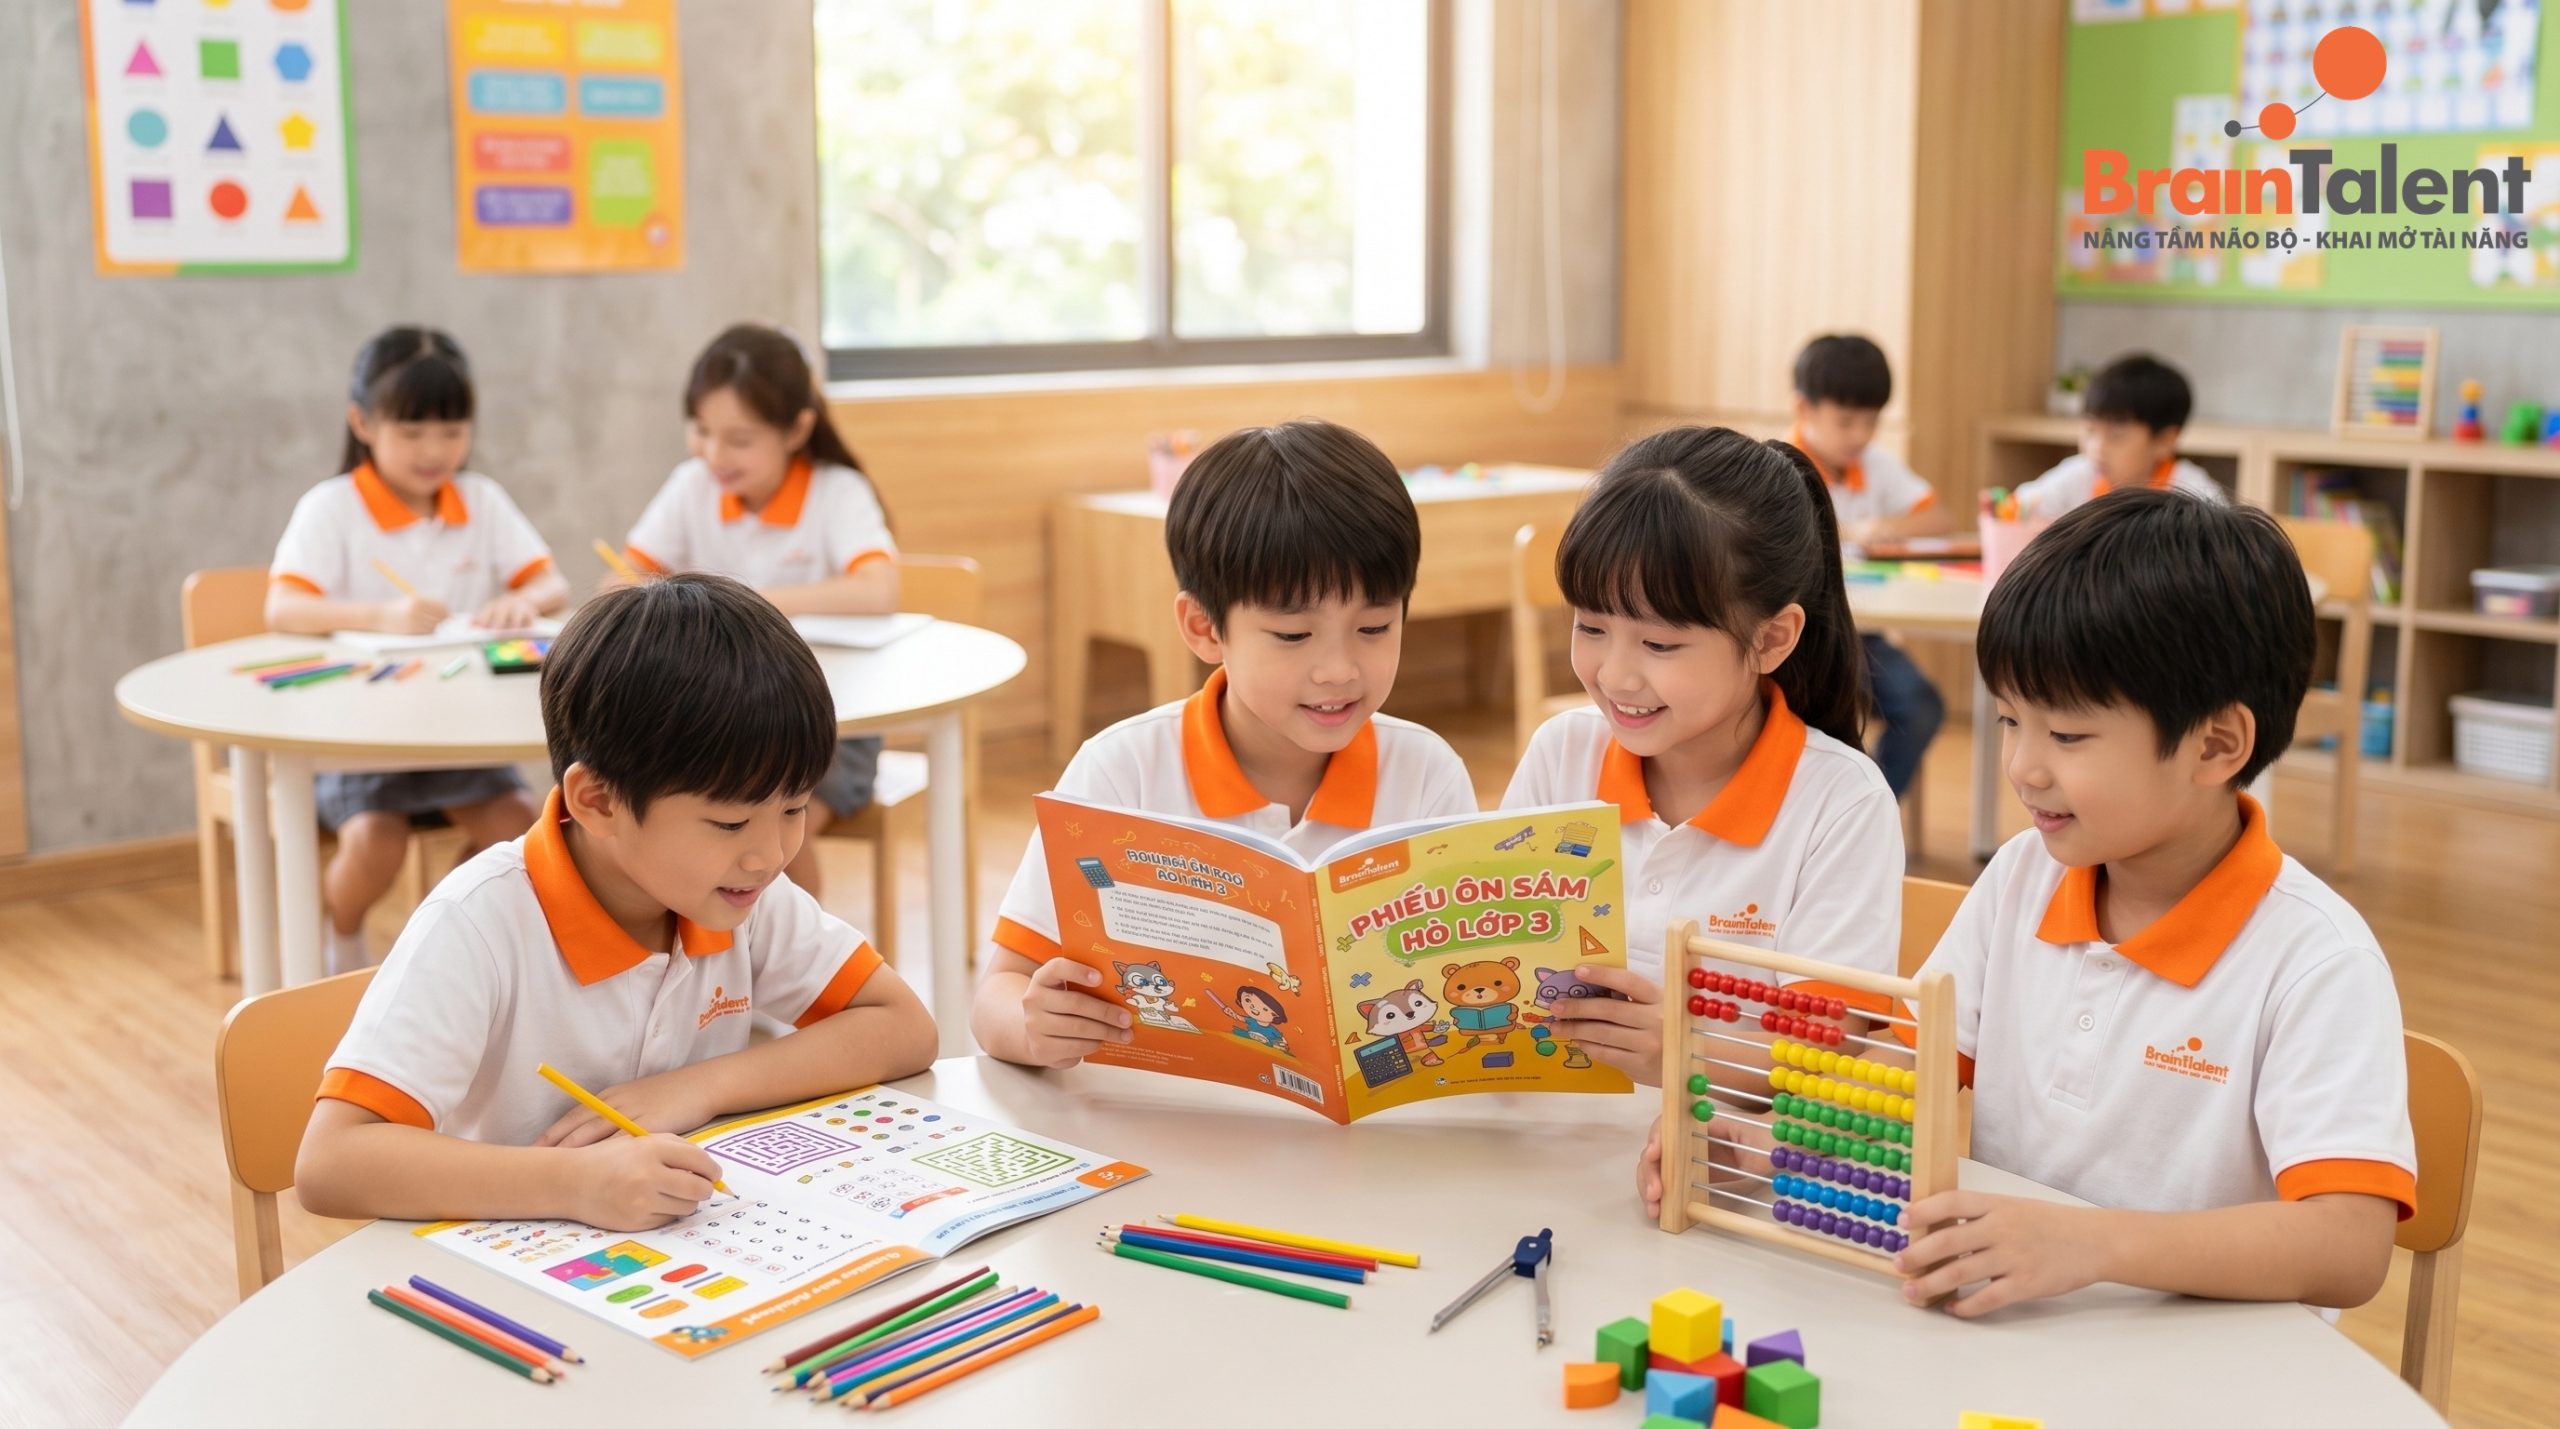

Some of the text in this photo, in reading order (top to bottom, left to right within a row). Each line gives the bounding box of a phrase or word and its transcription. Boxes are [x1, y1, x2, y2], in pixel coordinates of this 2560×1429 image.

[1349, 884, 1447, 938] PHIẾU
[1455, 877, 1504, 904] ÔN
[1512, 871, 1588, 899] SÁM
[1401, 911, 1550, 952] HÒ LỚP 3
